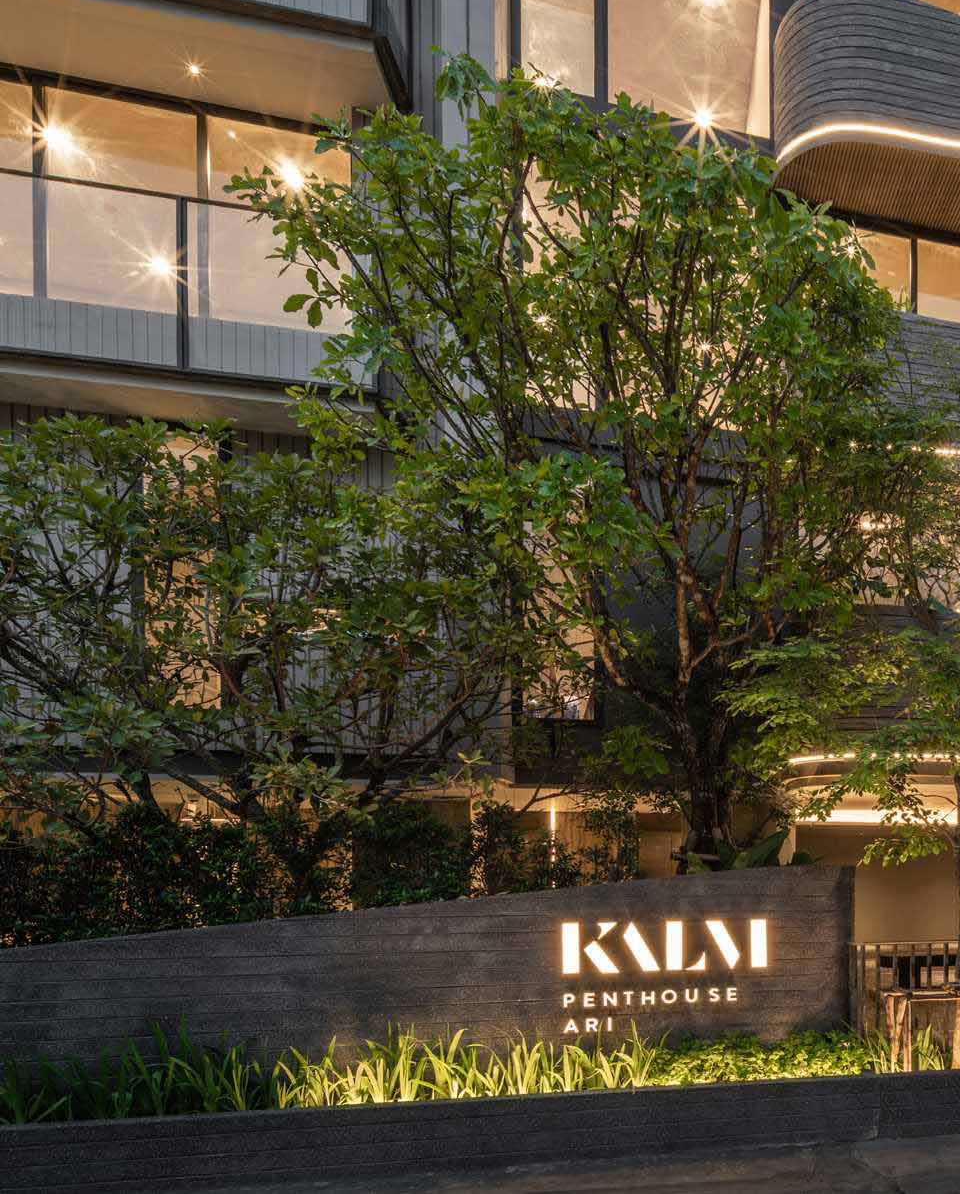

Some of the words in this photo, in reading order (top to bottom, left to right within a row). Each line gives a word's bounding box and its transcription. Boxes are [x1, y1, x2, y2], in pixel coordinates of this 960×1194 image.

[561, 918, 768, 974] KALM
[563, 987, 738, 1008] PENTHOUSE
[563, 1017, 613, 1034] ARI
